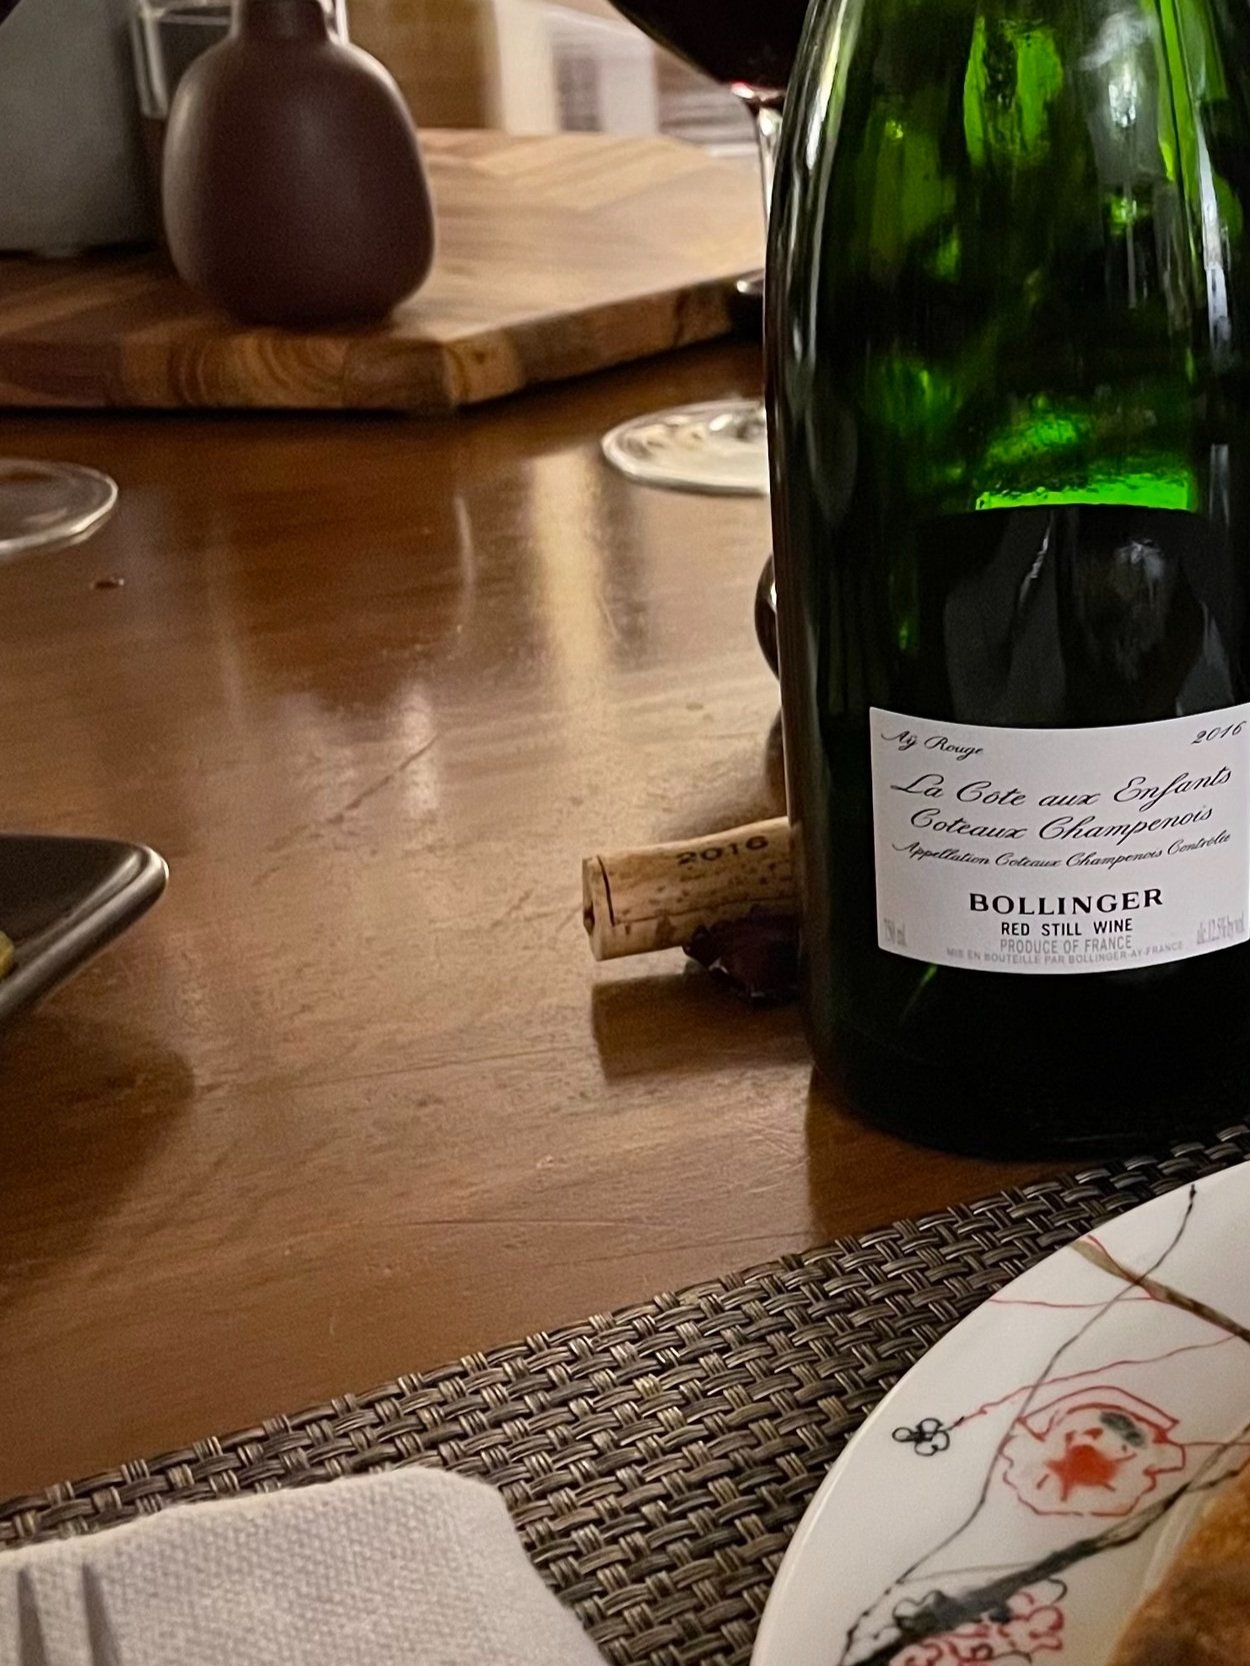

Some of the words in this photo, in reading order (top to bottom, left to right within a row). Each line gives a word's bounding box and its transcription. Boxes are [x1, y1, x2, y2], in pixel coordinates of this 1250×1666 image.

[1191, 720, 1247, 745] 2016
[923, 736, 984, 761] Rouge
[889, 773, 944, 799] La
[1038, 793, 1101, 807] aux
[1113, 765, 1232, 813] Enfants
[910, 807, 1028, 839] Coteaux
[1038, 803, 1213, 846] Champenois
[891, 841, 991, 865] Appellation
[995, 852, 1062, 867] Coteaux
[1066, 851, 1163, 870] Champenois
[969, 888, 1163, 915] BOLLINGER
[1001, 921, 1031, 937] RED
[1041, 922, 1083, 937] STILL
[1093, 917, 1133, 935] WINE
[1000, 939, 1058, 955] PRODUCE
[1063, 939, 1080, 955] OF
[1084, 935, 1133, 953] FRANCE
